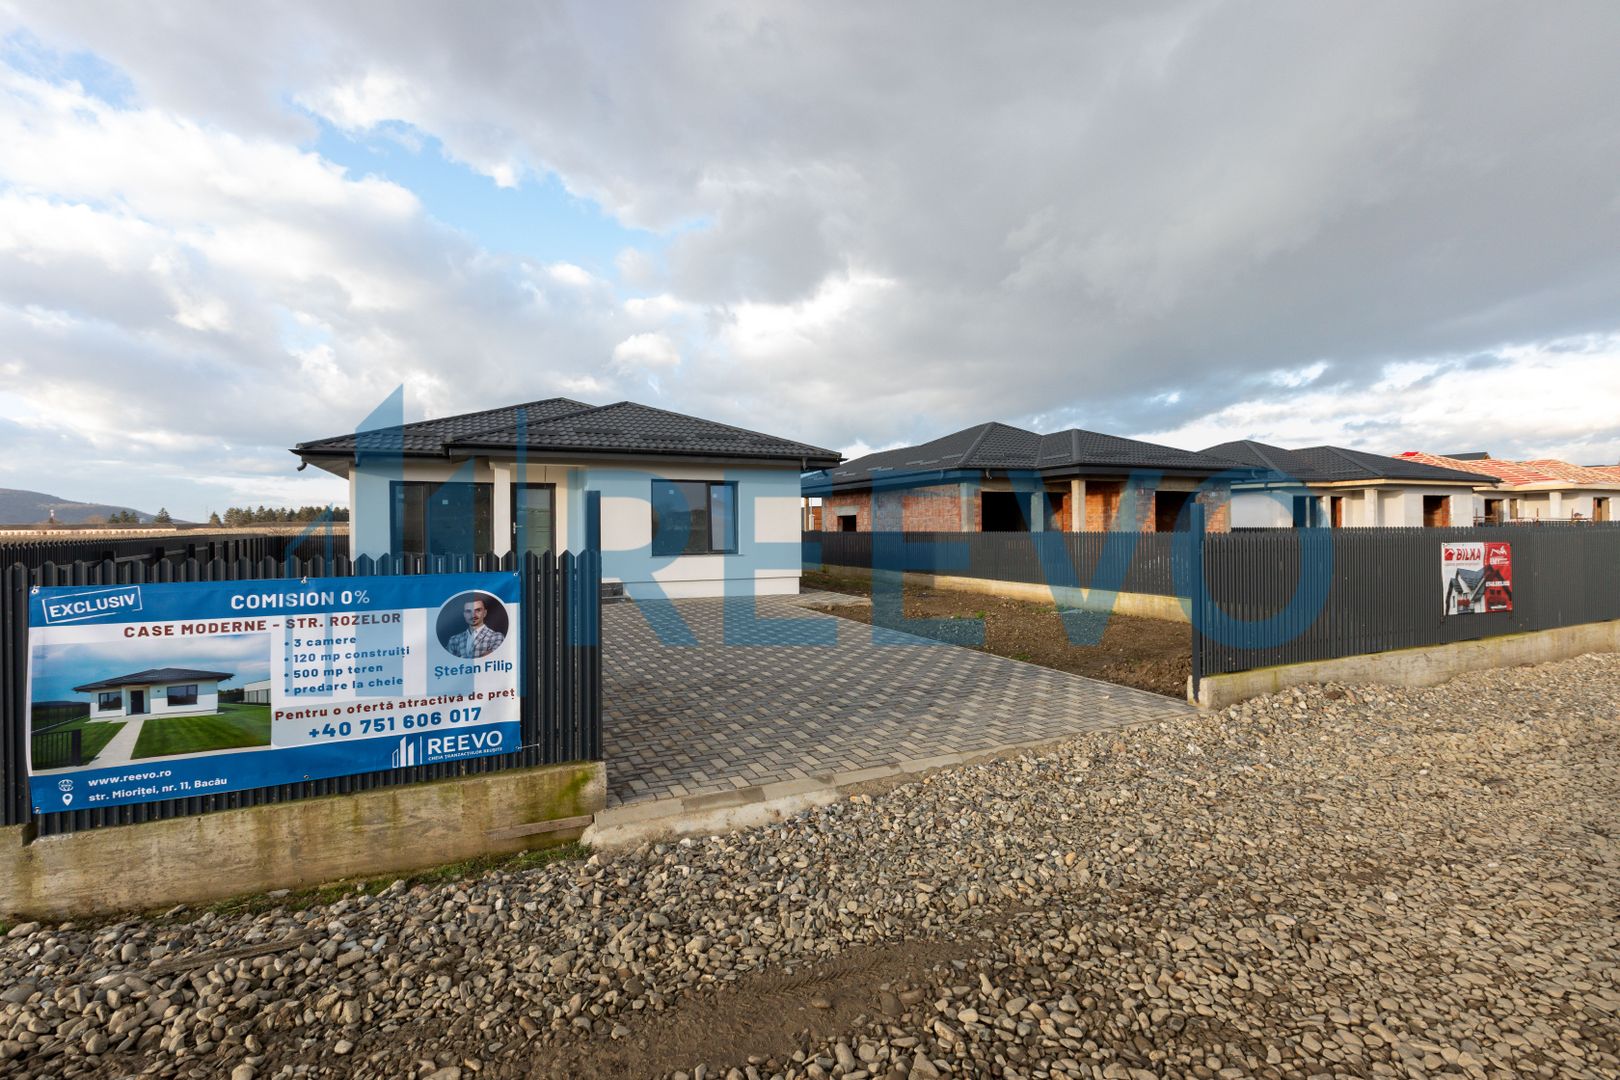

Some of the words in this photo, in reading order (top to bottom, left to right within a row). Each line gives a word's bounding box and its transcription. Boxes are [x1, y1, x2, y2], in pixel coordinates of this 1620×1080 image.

[1456, 548, 1481, 560] BILKA
[49, 593, 135, 618] EXCLUSIV
[230, 591, 335, 610] COMISION
[341, 590, 370, 605] 0%
[124, 624, 174, 638] CASE
[181, 620, 267, 635] MODERNE
[286, 618, 324, 629] STR.
[330, 613, 401, 626] ROZELOR
[294, 638, 302, 648] 3
[306, 636, 356, 646] camere
[294, 653, 316, 663] 120
[320, 653, 340, 662] mp
[294, 668, 318, 678] 500
[324, 668, 344, 678] mp
[348, 664, 383, 674] teren
[434, 664, 481, 680] Ștefan
[485, 660, 513, 672] Filip
[294, 683, 348, 696] predare
[352, 680, 364, 689] la
[368, 676, 404, 688] cheie
[275, 708, 328, 720] Pentru
[333, 708, 341, 716] o
[347, 701, 394, 714] ofertă
[468, 692, 484, 700] de
[309, 722, 352, 738] +40
[360, 716, 395, 734] 751
[403, 712, 442, 728] 606
[450, 706, 482, 722] 017
[428, 730, 503, 755] REEVO
[88, 770, 172, 787] www.reevo.ro
[88, 792, 110, 802] str.
[162, 784, 177, 793] nr.
[180, 781, 192, 790] 11,
